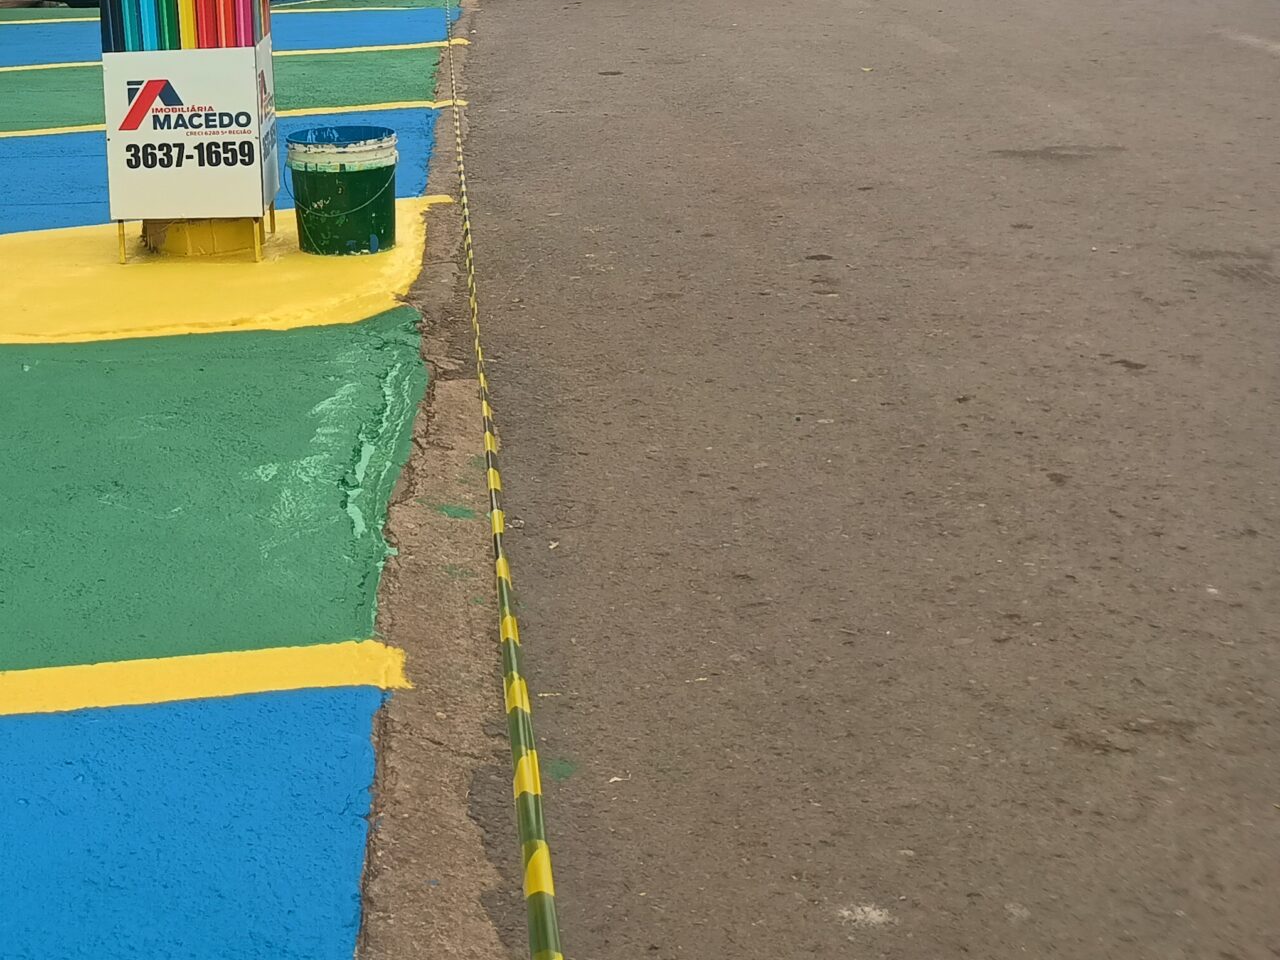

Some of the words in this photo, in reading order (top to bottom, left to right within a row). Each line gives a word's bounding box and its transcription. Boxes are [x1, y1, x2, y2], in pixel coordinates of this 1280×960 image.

[151, 105, 215, 114] IMOBILIÁRIA
[152, 111, 252, 130] MACEDO
[228, 128, 252, 136] REGIÃO
[125, 140, 255, 169] 3637-1659
